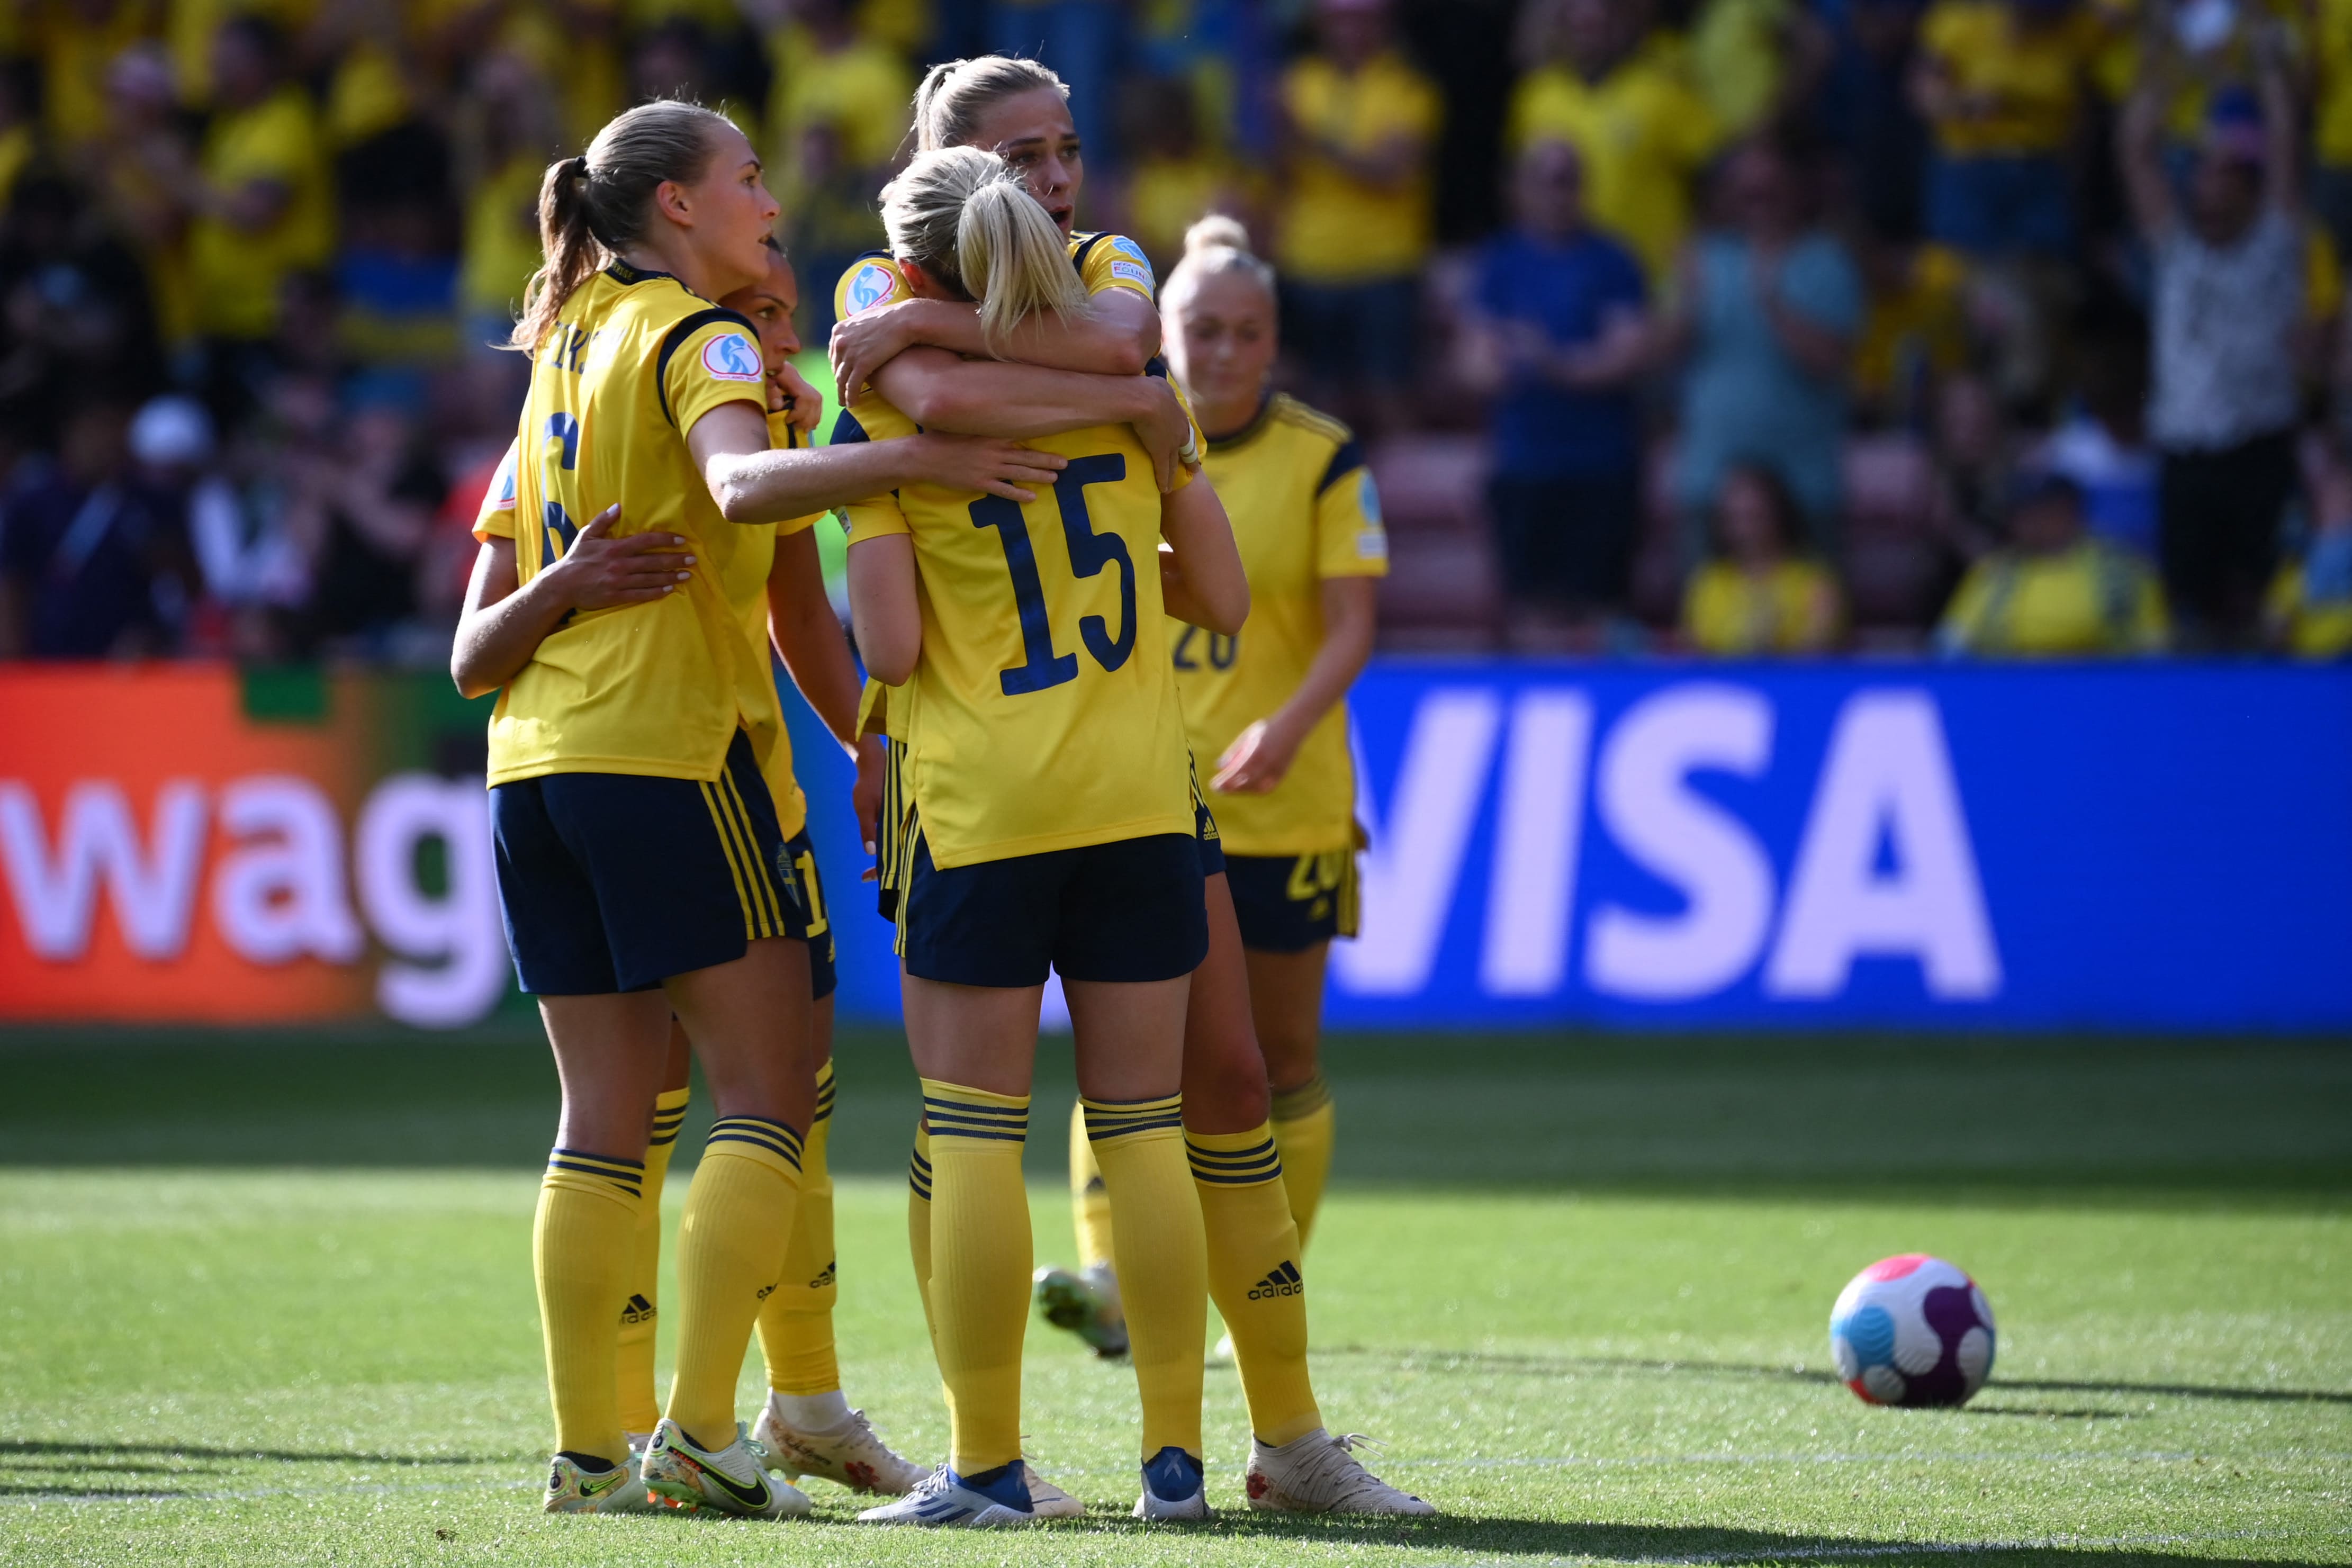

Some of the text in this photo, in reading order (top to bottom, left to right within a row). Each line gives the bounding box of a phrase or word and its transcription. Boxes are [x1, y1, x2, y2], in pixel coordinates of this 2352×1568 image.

[969, 453, 1137, 696] 15
[0, 776, 506, 1028] wag
[1332, 680, 2002, 1001] VISA
